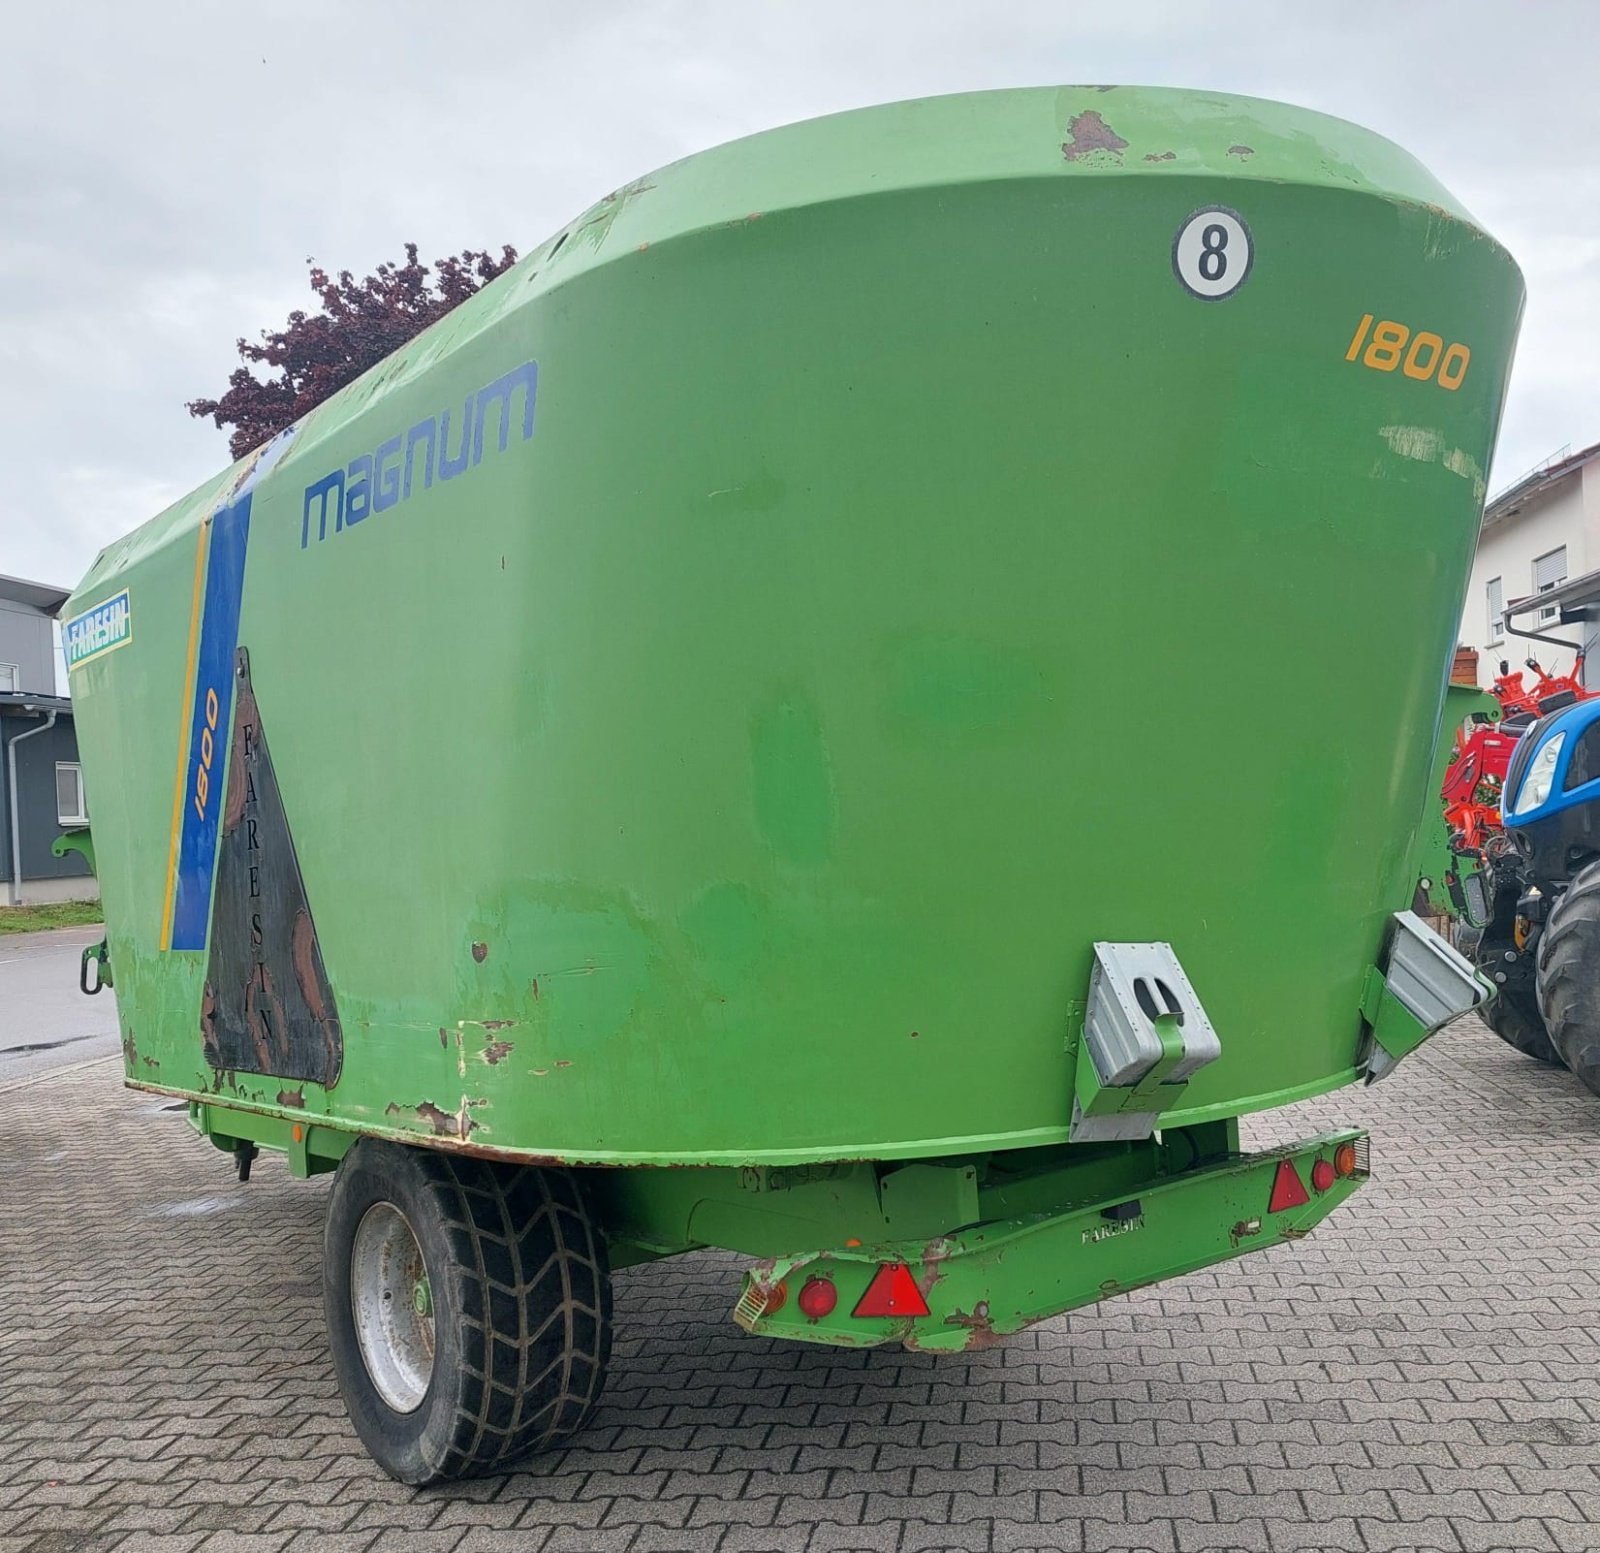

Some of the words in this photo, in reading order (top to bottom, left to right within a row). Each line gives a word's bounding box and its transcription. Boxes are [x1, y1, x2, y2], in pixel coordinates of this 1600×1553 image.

[1198, 223, 1229, 281] 8
[1345, 313, 1471, 391] 1800
[70, 598, 128, 660] FARESIN
[194, 687, 218, 822] 1800
[242, 724, 273, 1041] FARESIN
